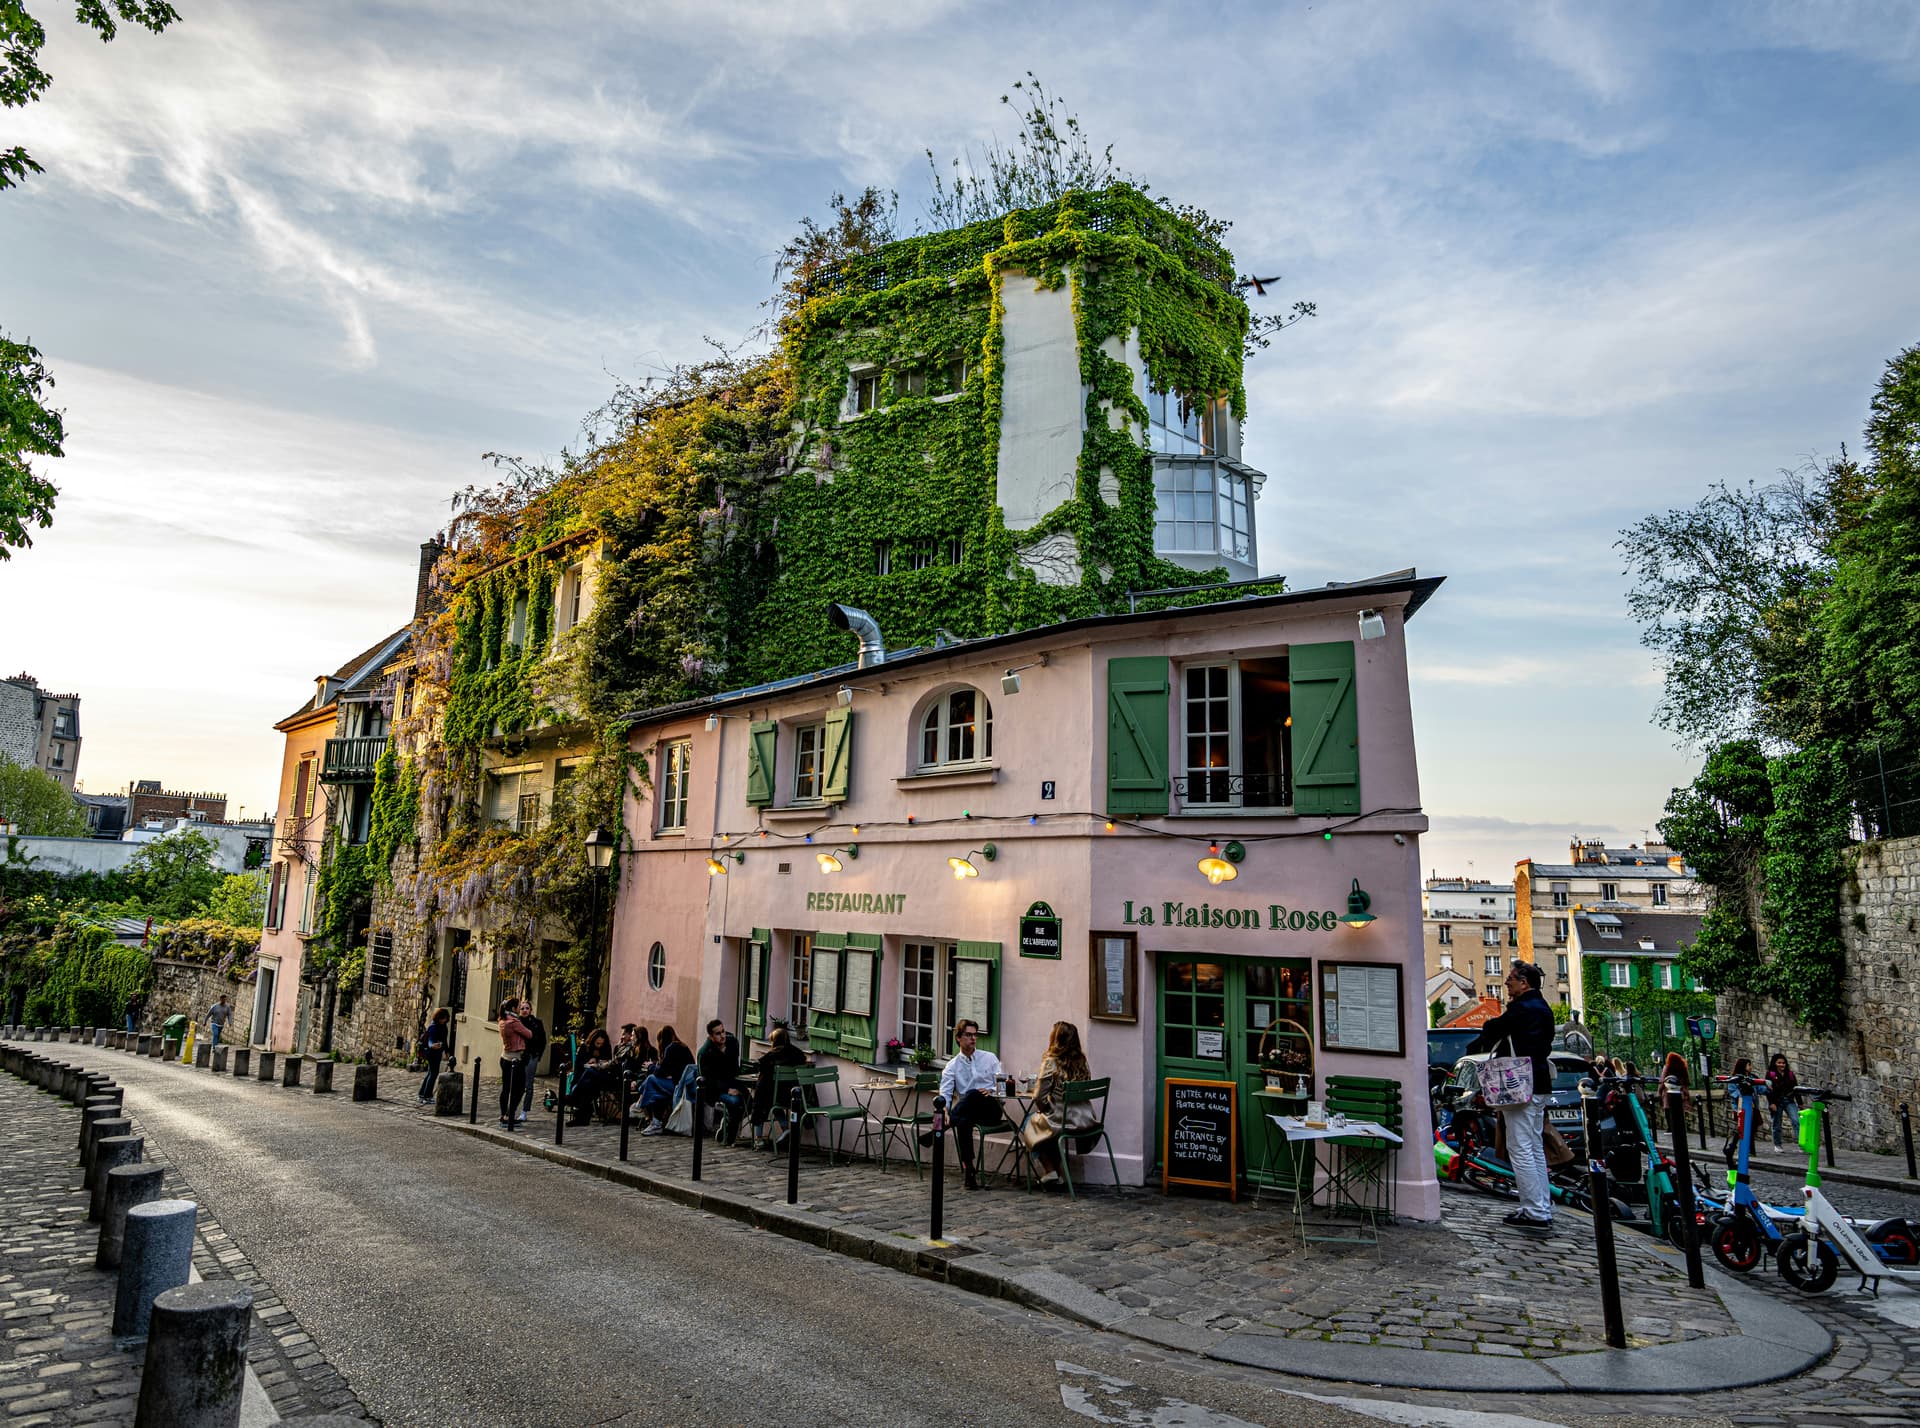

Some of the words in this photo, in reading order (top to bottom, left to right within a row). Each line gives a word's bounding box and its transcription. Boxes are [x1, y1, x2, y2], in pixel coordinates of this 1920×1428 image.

[1044, 782, 1052, 798] 2
[806, 892, 906, 914] RESTAURANT
[1122, 901, 1155, 926] La
[1161, 901, 1260, 929] Maison
[1268, 904, 1338, 931] Rose
[1035, 927, 1044, 935] RUE
[1023, 937, 1029, 945] DE
[1204, 1092, 1216, 1100] PAR
[1219, 1093, 1228, 1101] LA
[1196, 1102, 1206, 1110] DE
[1174, 1129, 1215, 1142] ENTRANCE
[1216, 1135, 1227, 1145] BY
[1174, 1142, 1188, 1150] THE
[1188, 1151, 1206, 1160] LEFT
[1207, 1153, 1223, 1162] SIDE
[1757, 1209, 1772, 1228] dott
